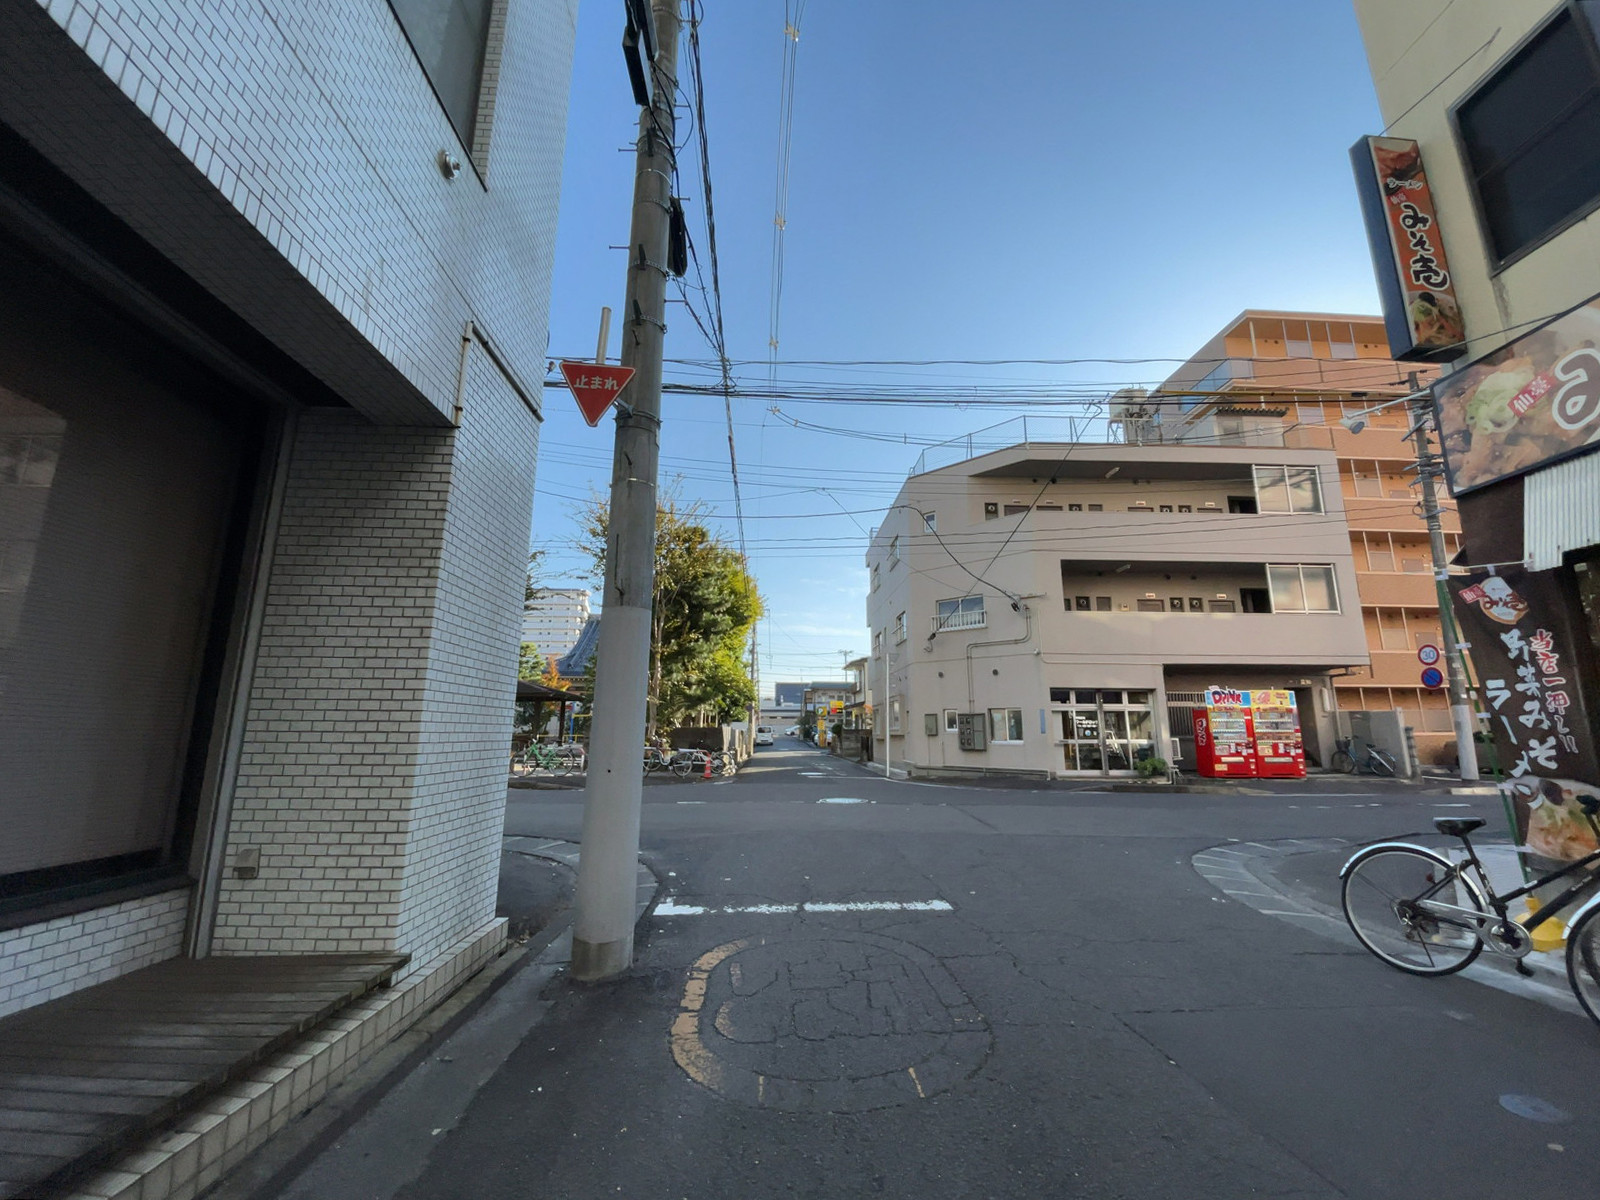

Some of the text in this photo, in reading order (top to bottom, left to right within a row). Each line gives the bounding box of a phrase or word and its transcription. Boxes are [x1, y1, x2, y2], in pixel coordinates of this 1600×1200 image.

[574, 375, 619, 390] 止まれ
[1422, 650, 1435, 661] 30
[1500, 628, 1559, 770] 野菜みそ
[1485, 678, 1544, 810] ラーメン
